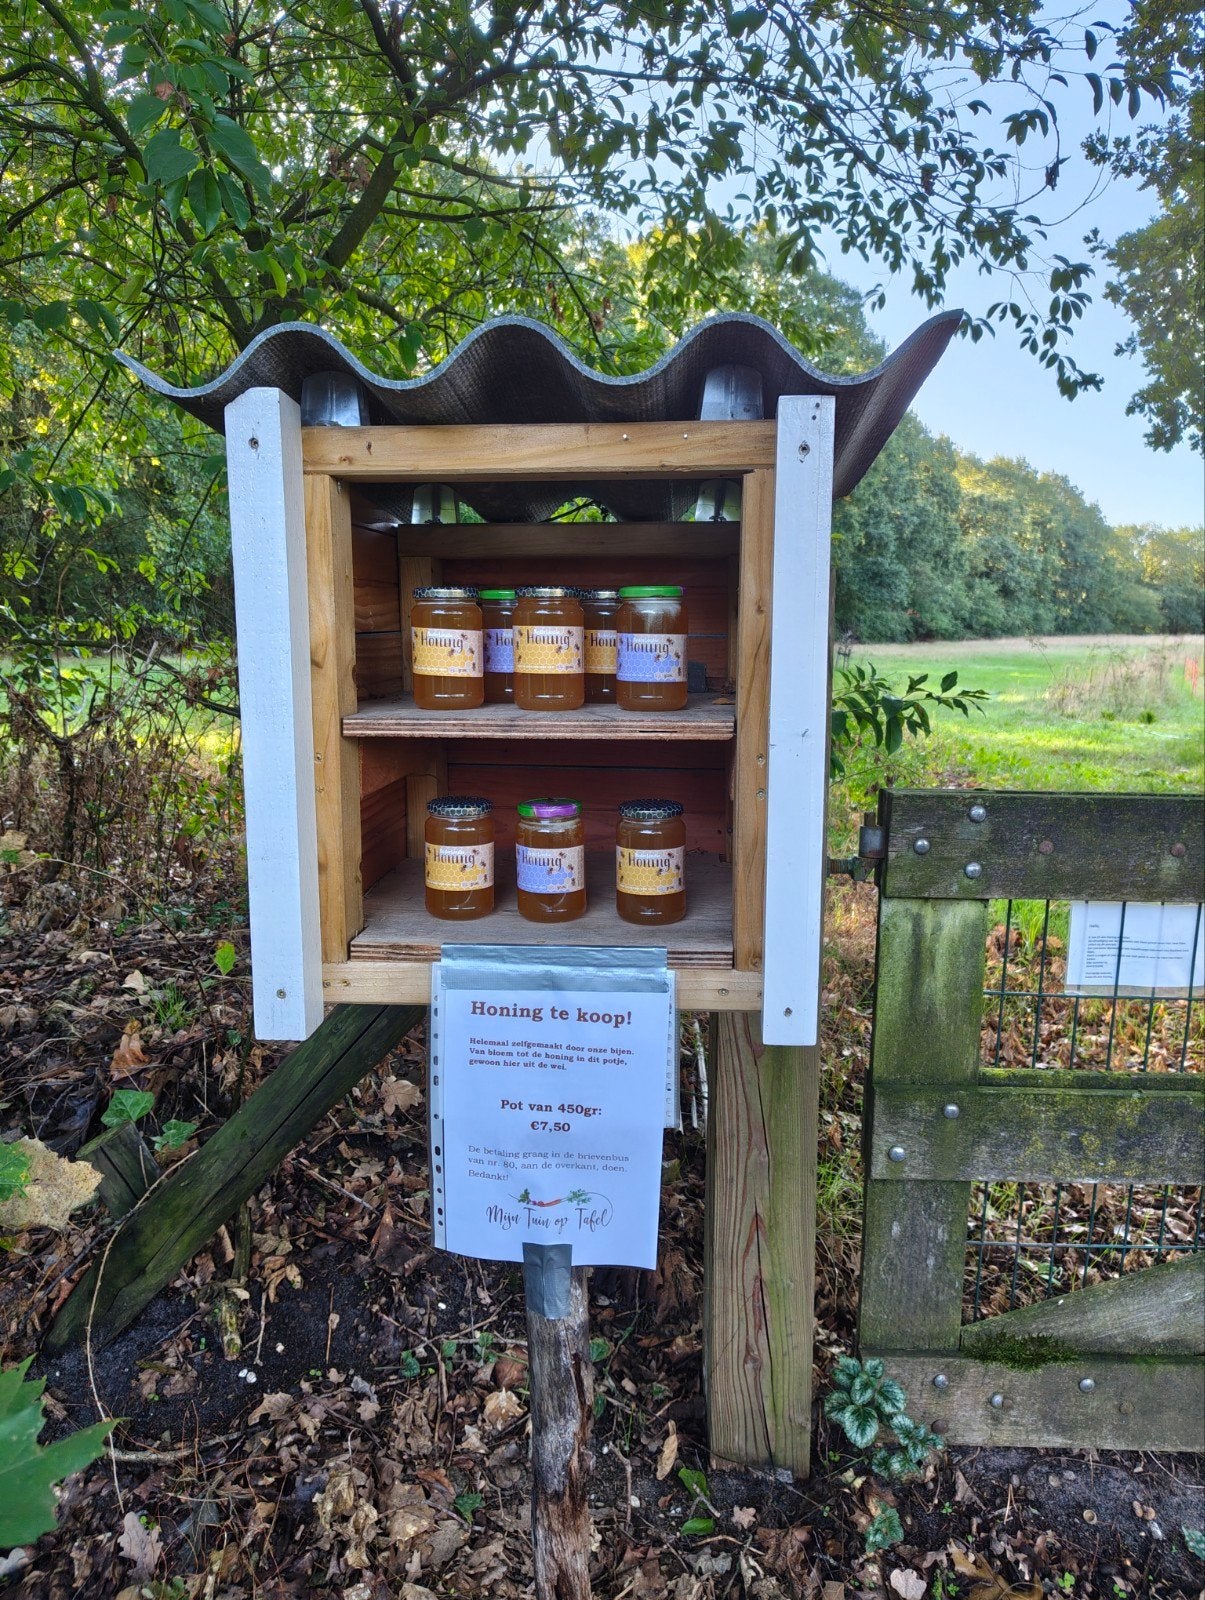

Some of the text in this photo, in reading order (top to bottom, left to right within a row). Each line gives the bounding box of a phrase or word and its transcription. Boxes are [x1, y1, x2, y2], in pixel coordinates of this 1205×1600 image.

[420, 630, 464, 652] Honing
[526, 632, 571, 652] Honing
[626, 635, 669, 657] Honing
[433, 848, 476, 870] Honing
[521, 851, 563, 870] Honing
[628, 852, 671, 873] Honing
[471, 1000, 632, 1028] Honing te koop!
[469, 1037, 634, 1057] Helemaal zelfgemaakt door onze bijen.
[469, 1058, 567, 1071] gewoon hier uit de wei.
[487, 1048, 514, 1057] bloem
[516, 1049, 529, 1058] tot
[531, 1050, 542, 1059] de
[544, 1051, 574, 1063] honing
[576, 1054, 585, 1062] in
[587, 1054, 600, 1063] dit
[602, 1056, 628, 1066] potje,
[500, 1099, 602, 1117] Pot van 450gr:
[530, 1121, 571, 1133] €7,50
[468, 1145, 629, 1162] De betaling graag in de brievenbus
[468, 1157, 485, 1165] van
[503, 1161, 518, 1170] 80,
[520, 1162, 539, 1170] aan
[541, 1161, 553, 1169] de
[555, 1162, 599, 1171] overkant,
[601, 1163, 628, 1173] doen.
[468, 1169, 509, 1181] Bedankt!
[486, 1204, 613, 1235] Mijn Tuin op Tafel
